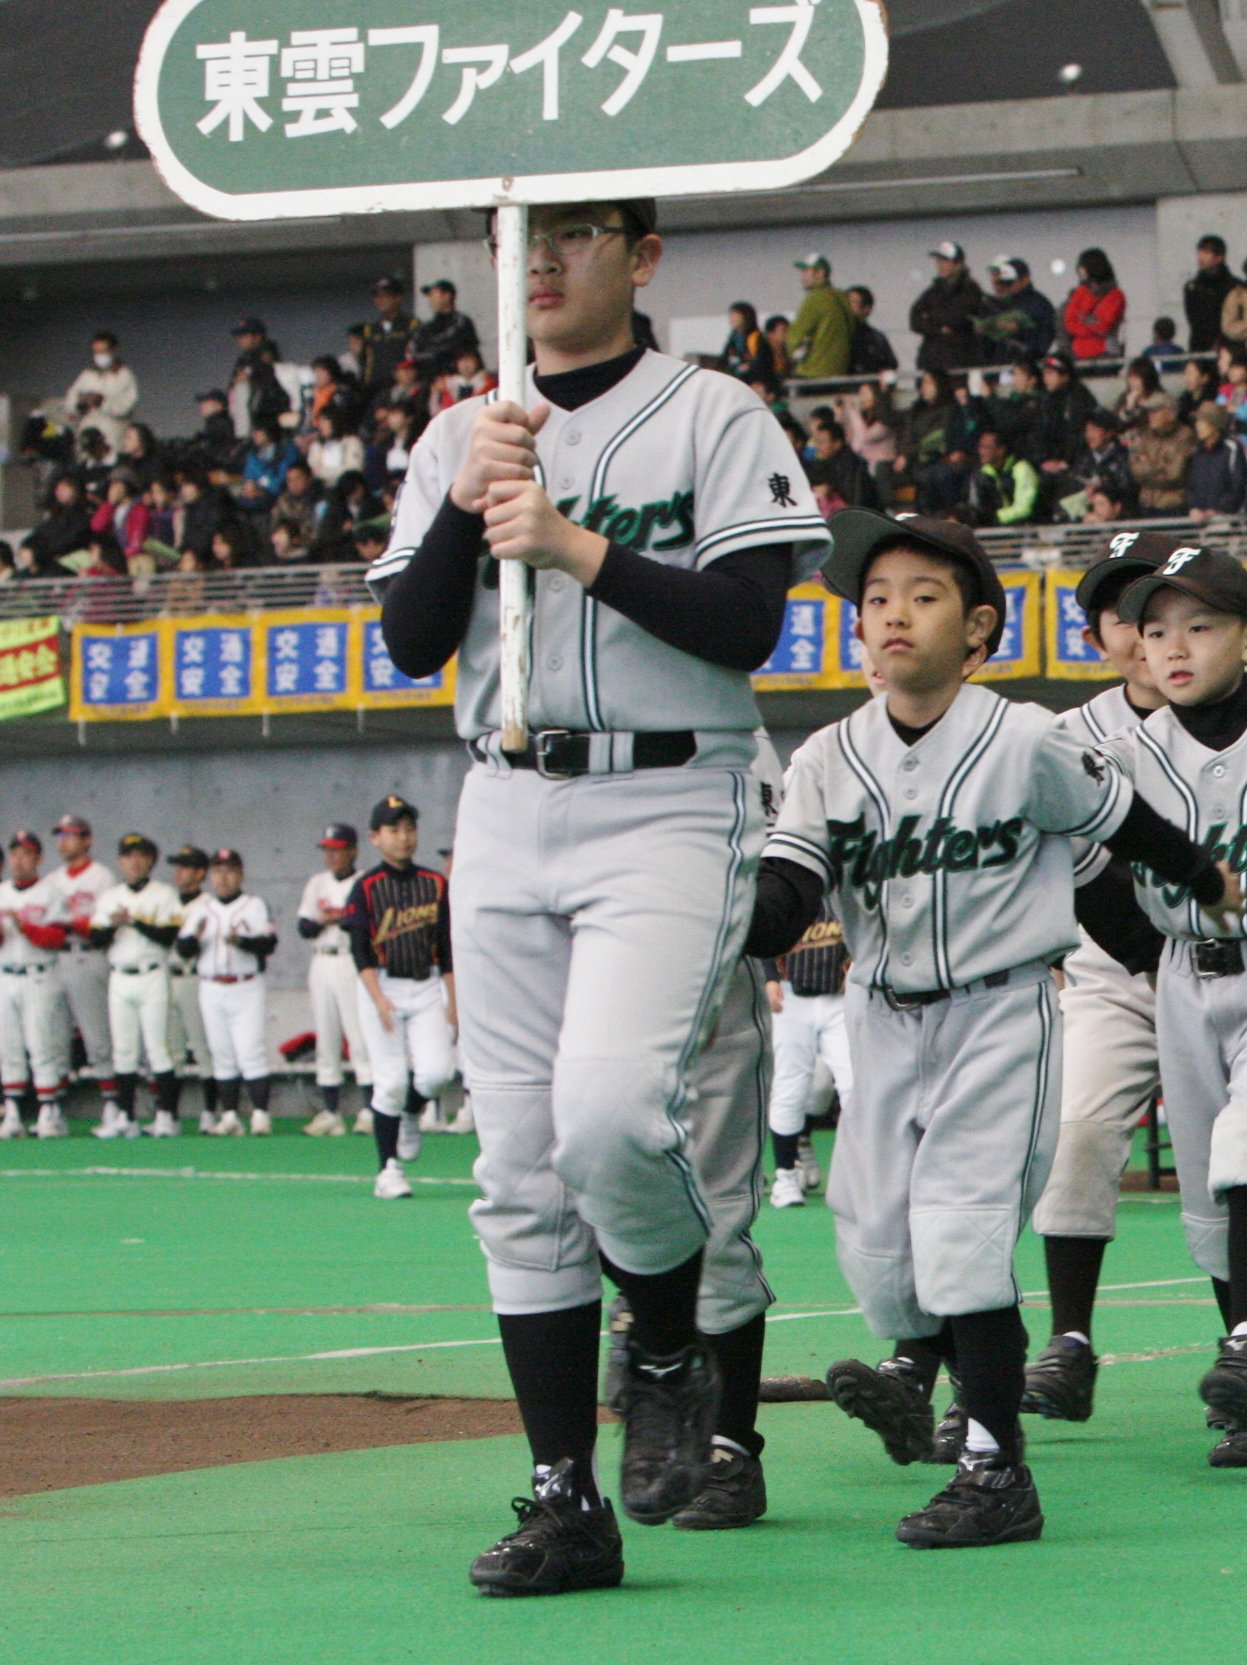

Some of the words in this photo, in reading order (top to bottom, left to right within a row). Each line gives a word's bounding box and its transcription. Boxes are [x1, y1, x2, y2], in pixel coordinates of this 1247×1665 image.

[195, 0, 824, 143] 東雲ファイターズ
[767, 472, 798, 508] 東
[790, 605, 816, 636] 通
[826, 811, 1023, 911] Fighters
[801, 921, 843, 942] ION
